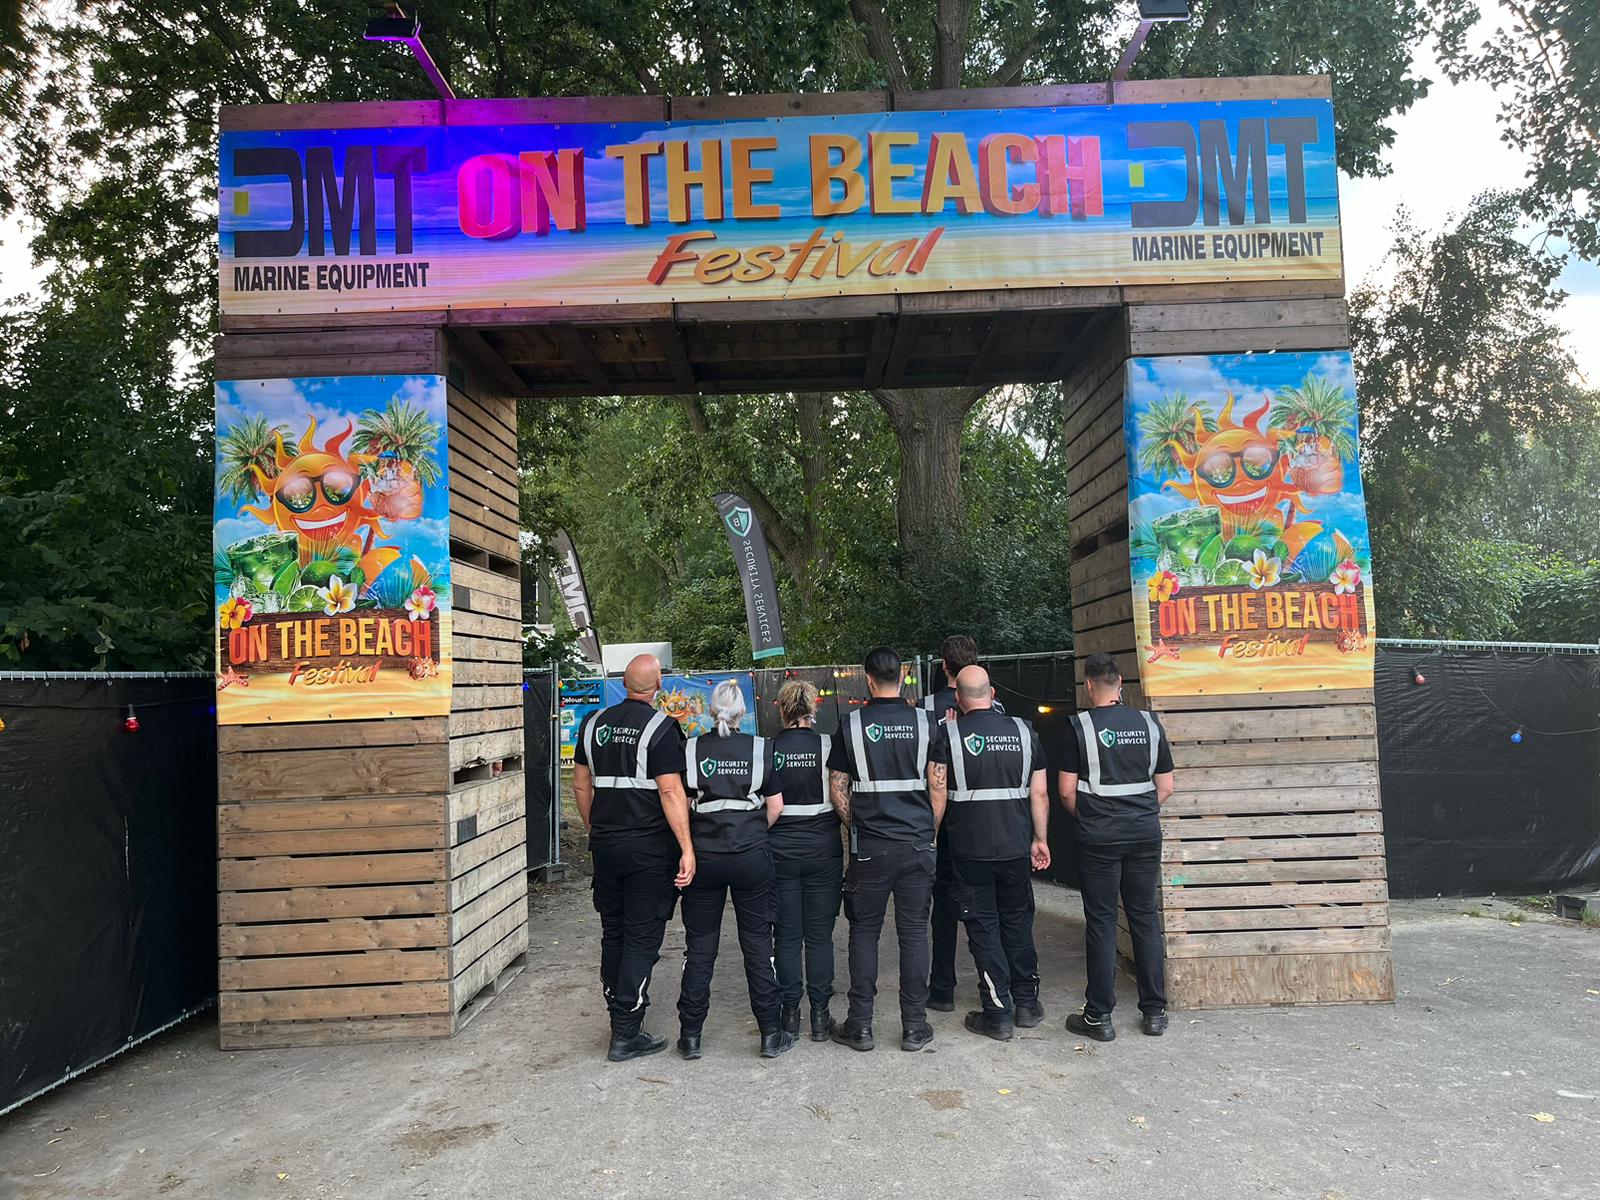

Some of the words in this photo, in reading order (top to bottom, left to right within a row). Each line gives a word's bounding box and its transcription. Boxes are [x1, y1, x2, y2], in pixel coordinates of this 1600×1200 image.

[457, 148, 586, 240] ON
[605, 137, 781, 227] THE
[809, 132, 1104, 219] BEACH
[1127, 117, 1318, 229] DMT
[233, 145, 427, 258] DMT
[646, 226, 945, 285] Festival
[1132, 234, 1206, 262] MARINE
[1212, 231, 1324, 263] EQUIPMENT
[234, 264, 309, 292] MARINE
[316, 261, 430, 293] EQUIPMENT
[1158, 597, 1198, 638] ON
[1202, 592, 1258, 632] THE
[1264, 591, 1359, 630] BEACH
[228, 623, 269, 665] ON
[275, 618, 331, 659] THE
[339, 617, 432, 658] BEACH
[1217, 632, 1310, 659] Festival
[288, 659, 383, 686] Festival
[985, 735, 1020, 743] SECURITY
[986, 743, 1021, 752] SERVICES
[717, 760, 749, 768] SECURITY
